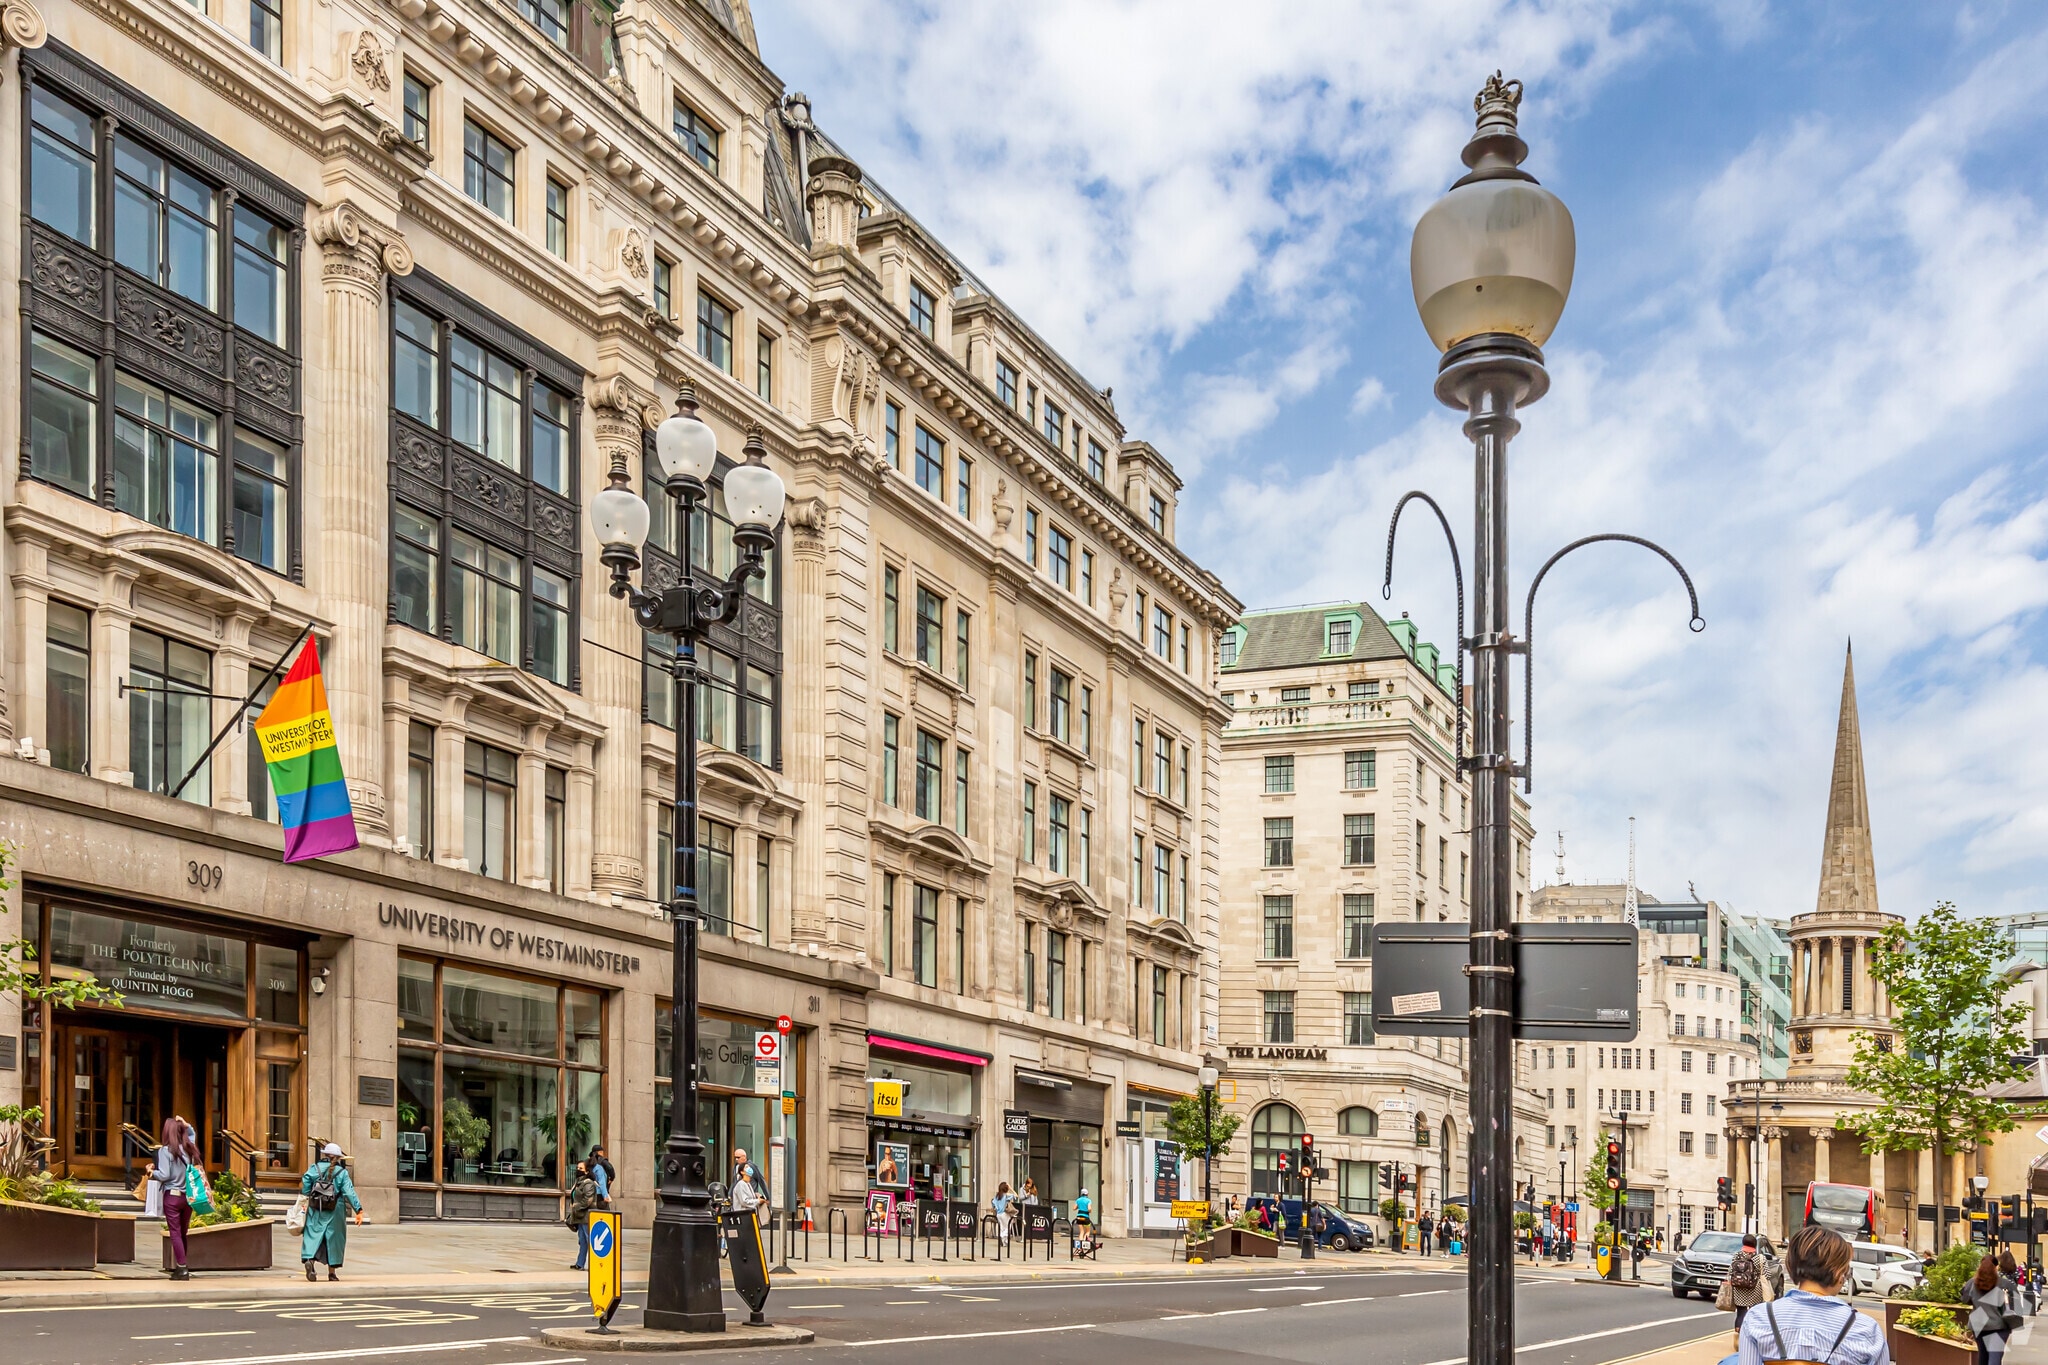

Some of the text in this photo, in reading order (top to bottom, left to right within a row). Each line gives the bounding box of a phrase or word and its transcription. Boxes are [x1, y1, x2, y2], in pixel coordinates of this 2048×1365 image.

[265, 718, 326, 744] UNIVERSITY OF
[187, 860, 223, 890] 309
[129, 934, 177, 954] Formerly
[378, 902, 631, 974] UNIVERSITY OF WESTMINSTER
[90, 943, 214, 975] THE POLYTECHNIC
[128, 967, 179, 985] Founded by
[268, 978, 286, 991] 309
[111, 977, 194, 999] QUINTIN HOGG
[808, 995, 820, 1014] 311
[778, 1019, 790, 1028] RD
[718, 1044, 754, 1067] Galler
[1226, 1047, 1328, 1061] THE LANGHAM
[877, 1092, 899, 1106] itsu
[1007, 1117, 1027, 1125] CARDS
